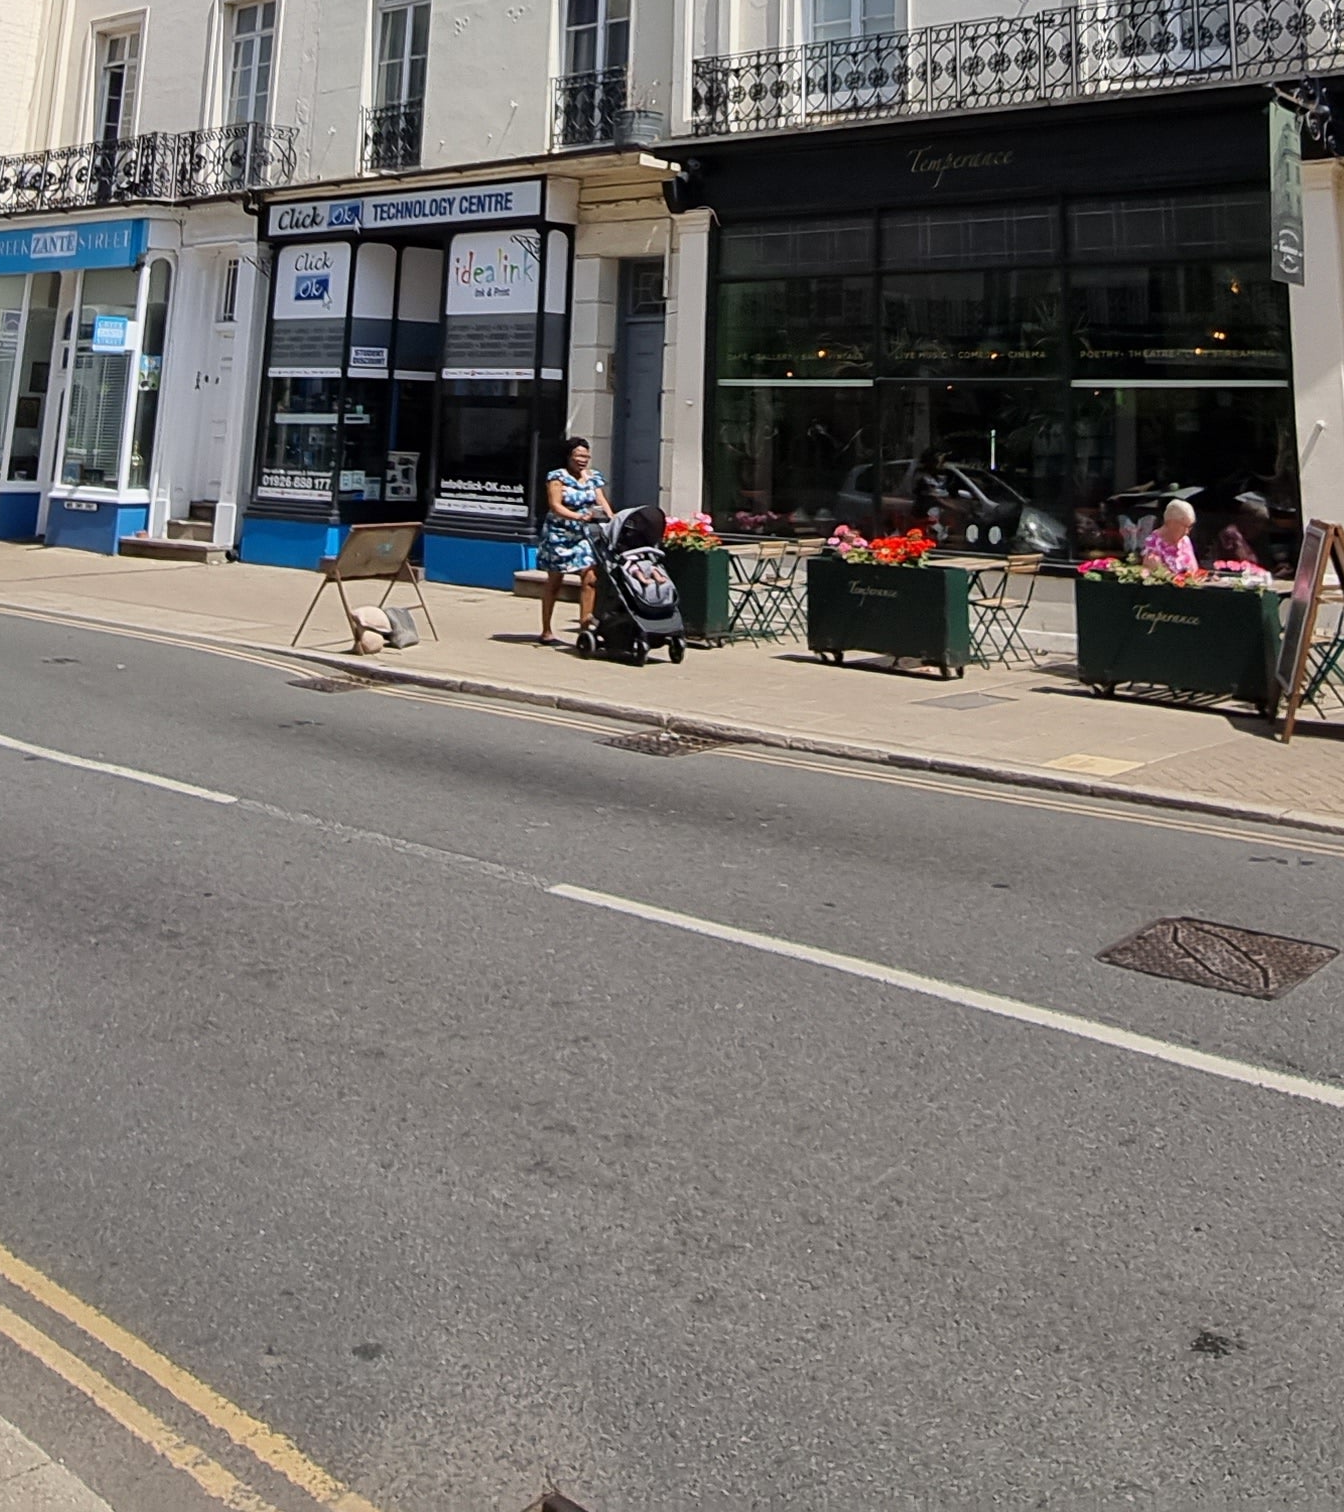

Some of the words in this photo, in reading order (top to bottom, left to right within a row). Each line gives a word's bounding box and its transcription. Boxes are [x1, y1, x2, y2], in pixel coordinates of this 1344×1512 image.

[906, 145, 1013, 189] Temperance
[277, 206, 324, 231] Click
[372, 198, 457, 222] TECHNOLOGY
[458, 191, 514, 215] CENTRE
[32, 231, 76, 255] ZANTE
[77, 229, 132, 250] STREET
[294, 251, 334, 271] Click
[1080, 351, 1120, 359] POETRY
[262, 474, 291, 487] 01926
[314, 478, 331, 490] 177
[1132, 603, 1201, 635] Temperance
